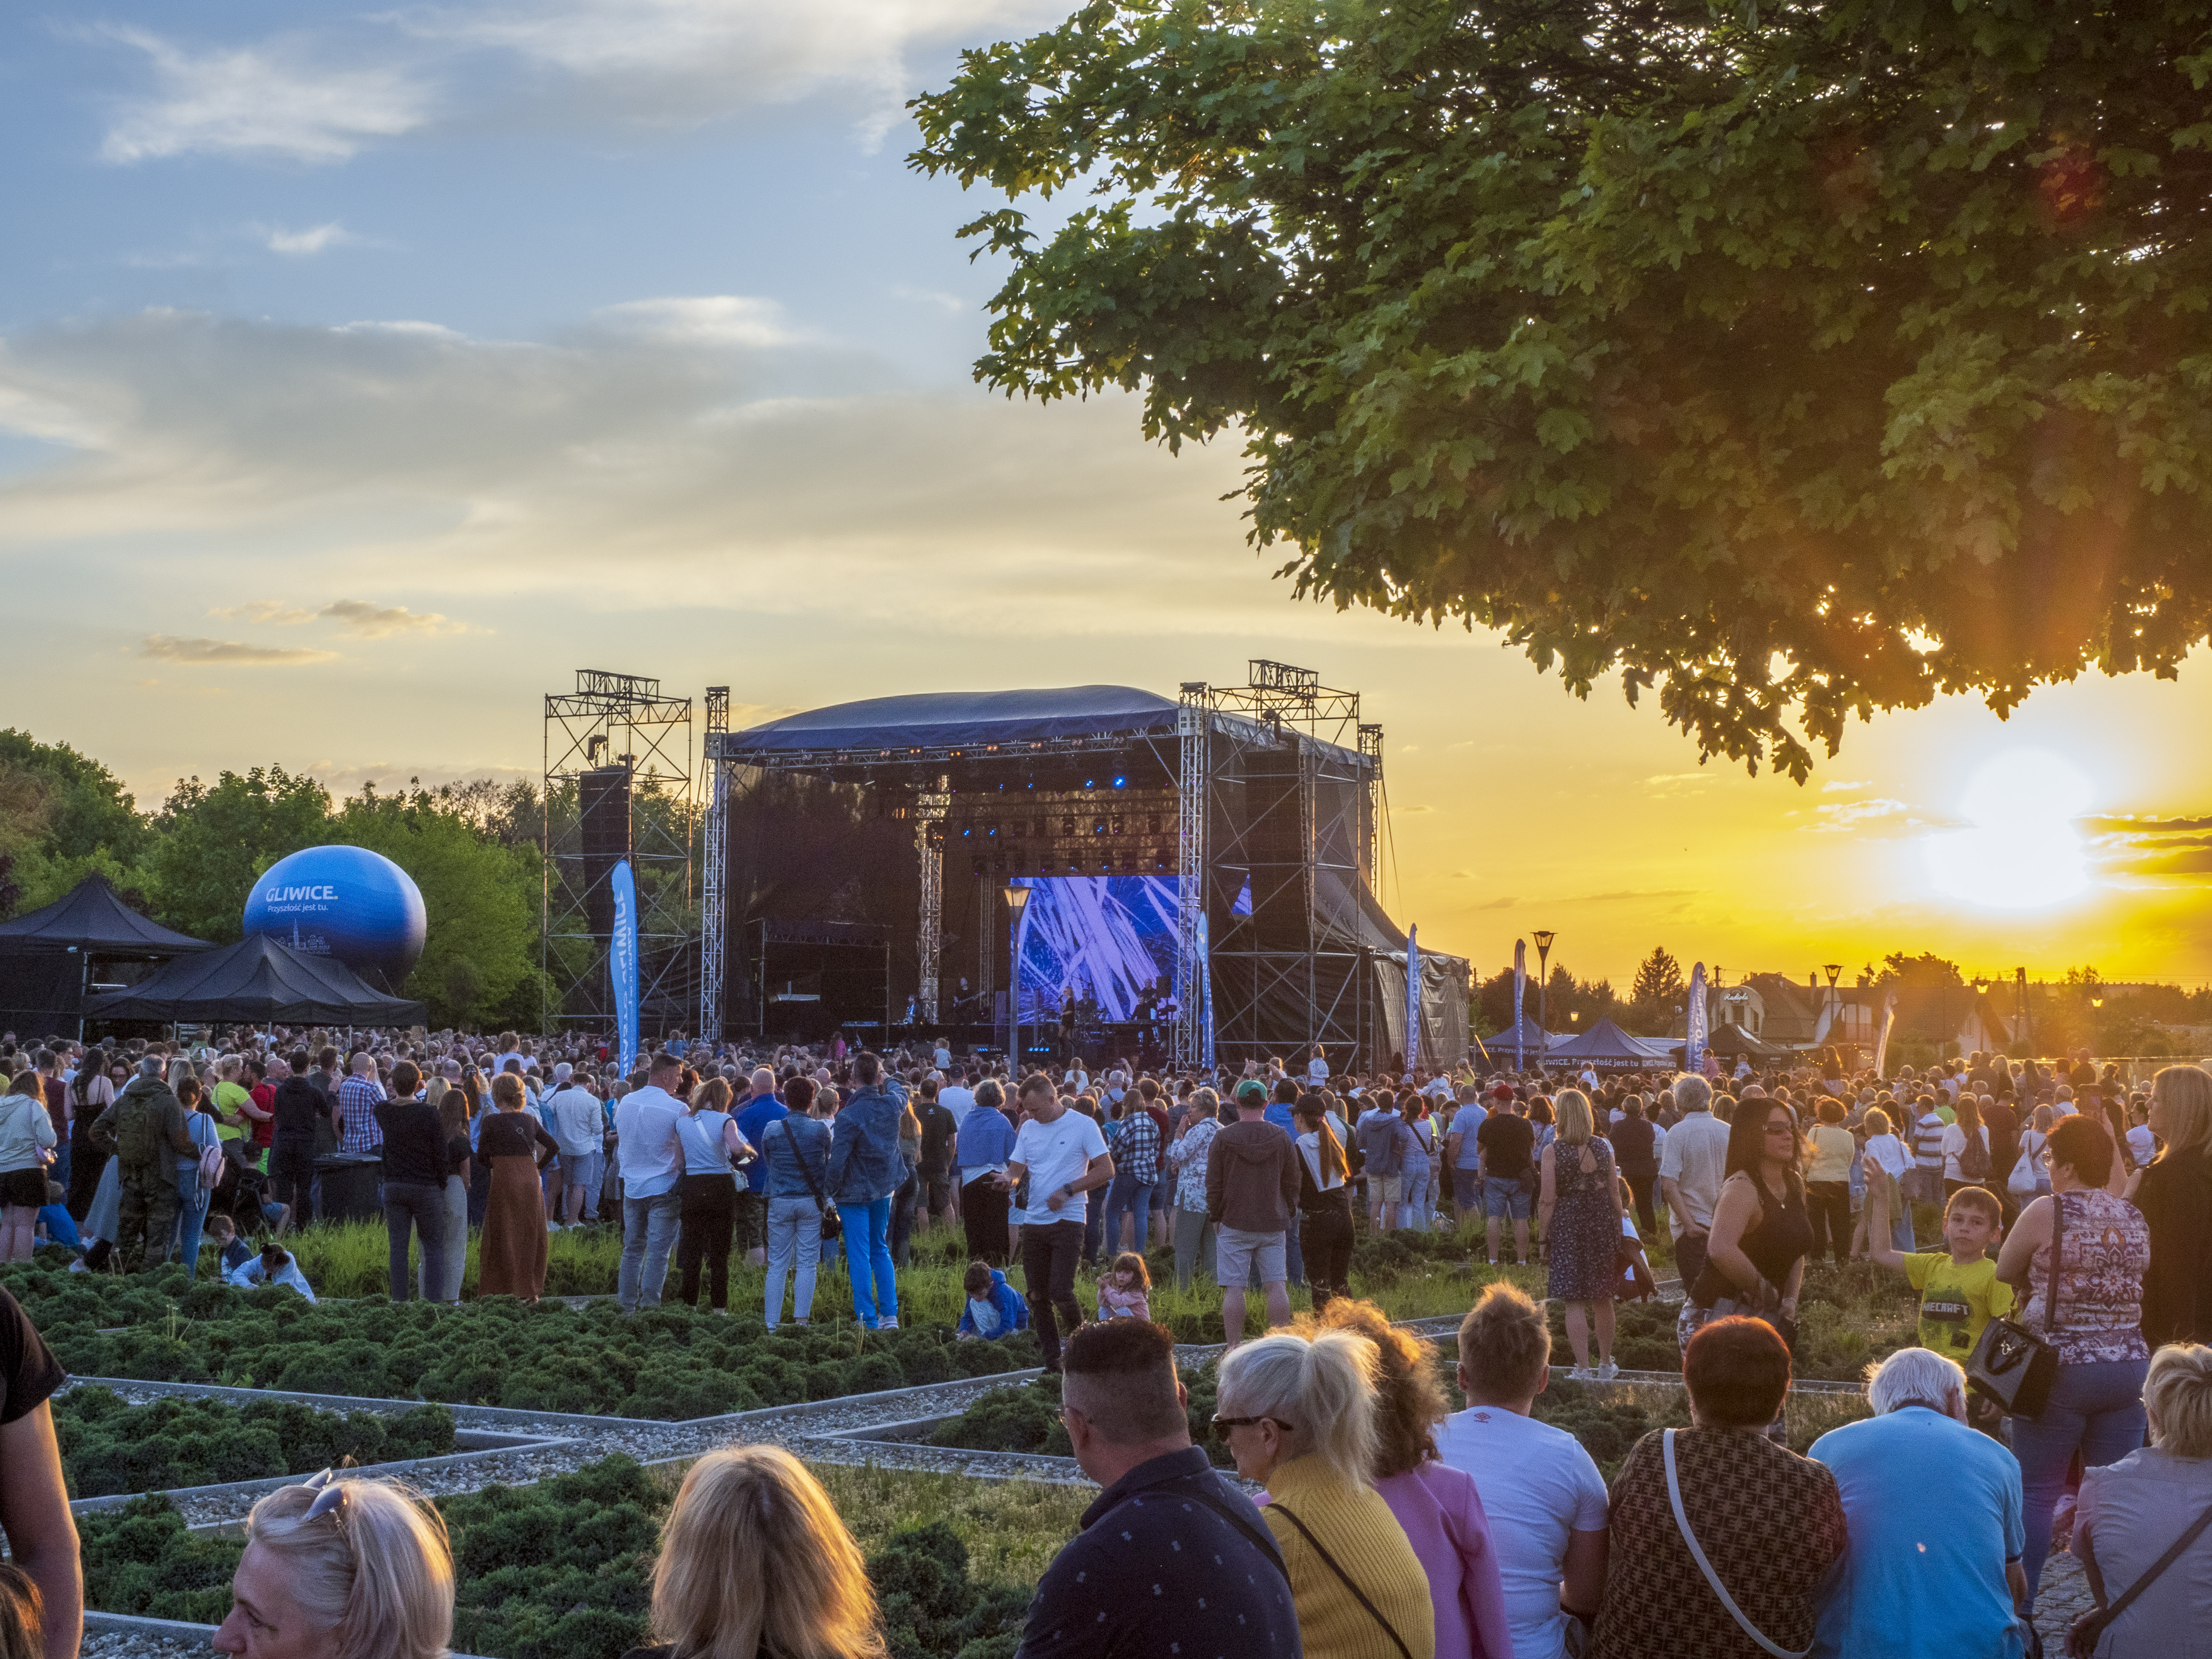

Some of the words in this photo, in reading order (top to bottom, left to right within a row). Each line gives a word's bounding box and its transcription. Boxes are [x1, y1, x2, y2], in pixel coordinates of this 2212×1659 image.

[268, 903, 301, 913] Przyszłość
[302, 903, 316, 912] jest
[1613, 1059, 1628, 1067] jest
